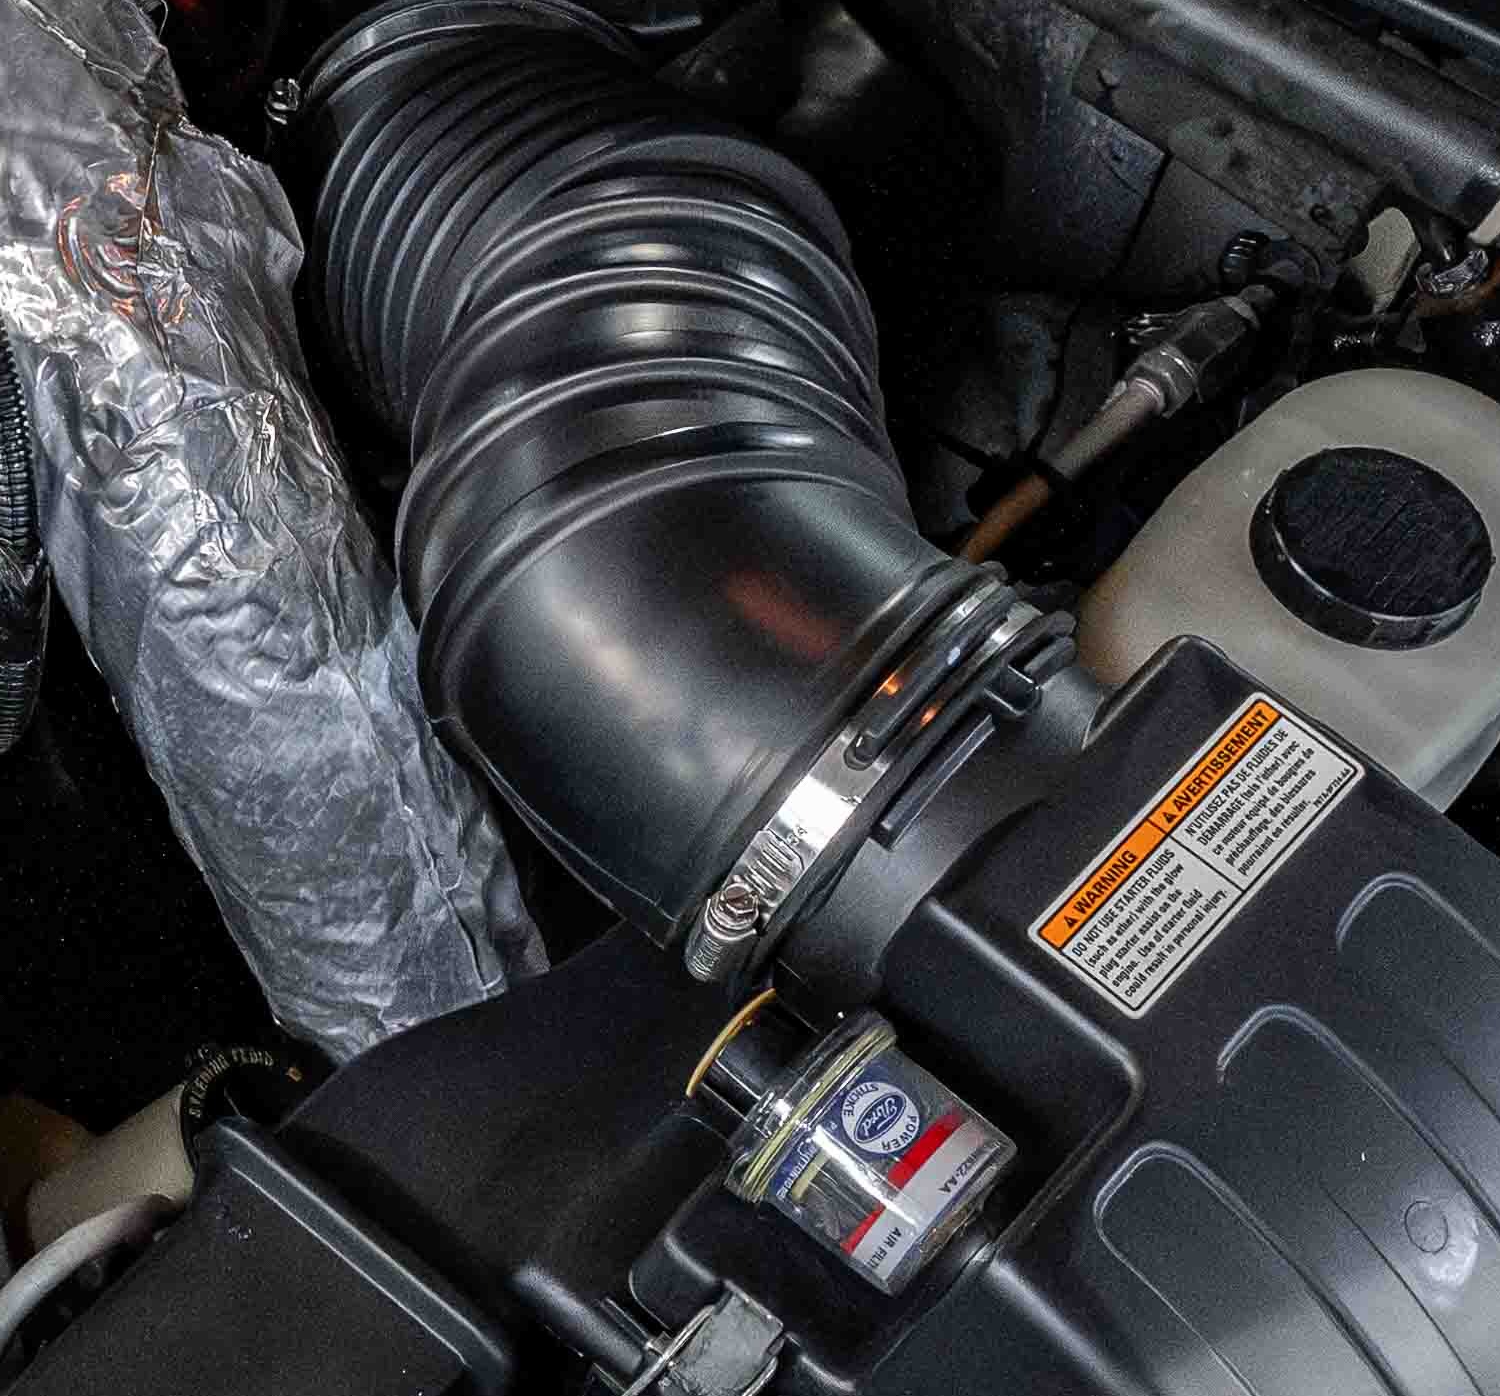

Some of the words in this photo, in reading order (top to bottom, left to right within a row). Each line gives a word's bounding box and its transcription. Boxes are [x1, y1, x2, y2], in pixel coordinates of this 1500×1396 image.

[1169, 708, 1271, 812] AVERTISSEMENT
[1070, 941, 1088, 957] DO
[1082, 924, 1103, 945] NOT
[1097, 908, 1119, 928] USE
[1112, 874, 1151, 913] STARTER
[1144, 847, 1176, 878] FLUIDS
[1072, 848, 1139, 915] WARNING
[1083, 943, 1110, 968] (such
[1105, 935, 1117, 946] as
[1112, 911, 1139, 937] ether)
[1132, 893, 1155, 915] with
[1149, 881, 1167, 897] the
[1161, 861, 1186, 885] glow
[1096, 956, 1120, 979] plug
[1113, 933, 1141, 960] starter
[1135, 909, 1162, 936] assist
[1158, 901, 1171, 913] on
[1166, 887, 1182, 902] the
[1109, 956, 1142, 989] engine.
[1136, 939, 1156, 957] Use
[1150, 929, 1165, 942] of
[1159, 906, 1187, 934] starter
[1181, 888, 1203, 909] fluid
[1122, 972, 1148, 997] could
[1141, 950, 1168, 976] result
[1162, 942, 1176, 954] in
[1169, 909, 1208, 947] personal
[1199, 885, 1230, 915] injury.
[844, 1086, 876, 1117] STROKE
[861, 1097, 897, 1137] Ford
[881, 1116, 916, 1150] POWER
[883, 1226, 901, 1248] AIR
